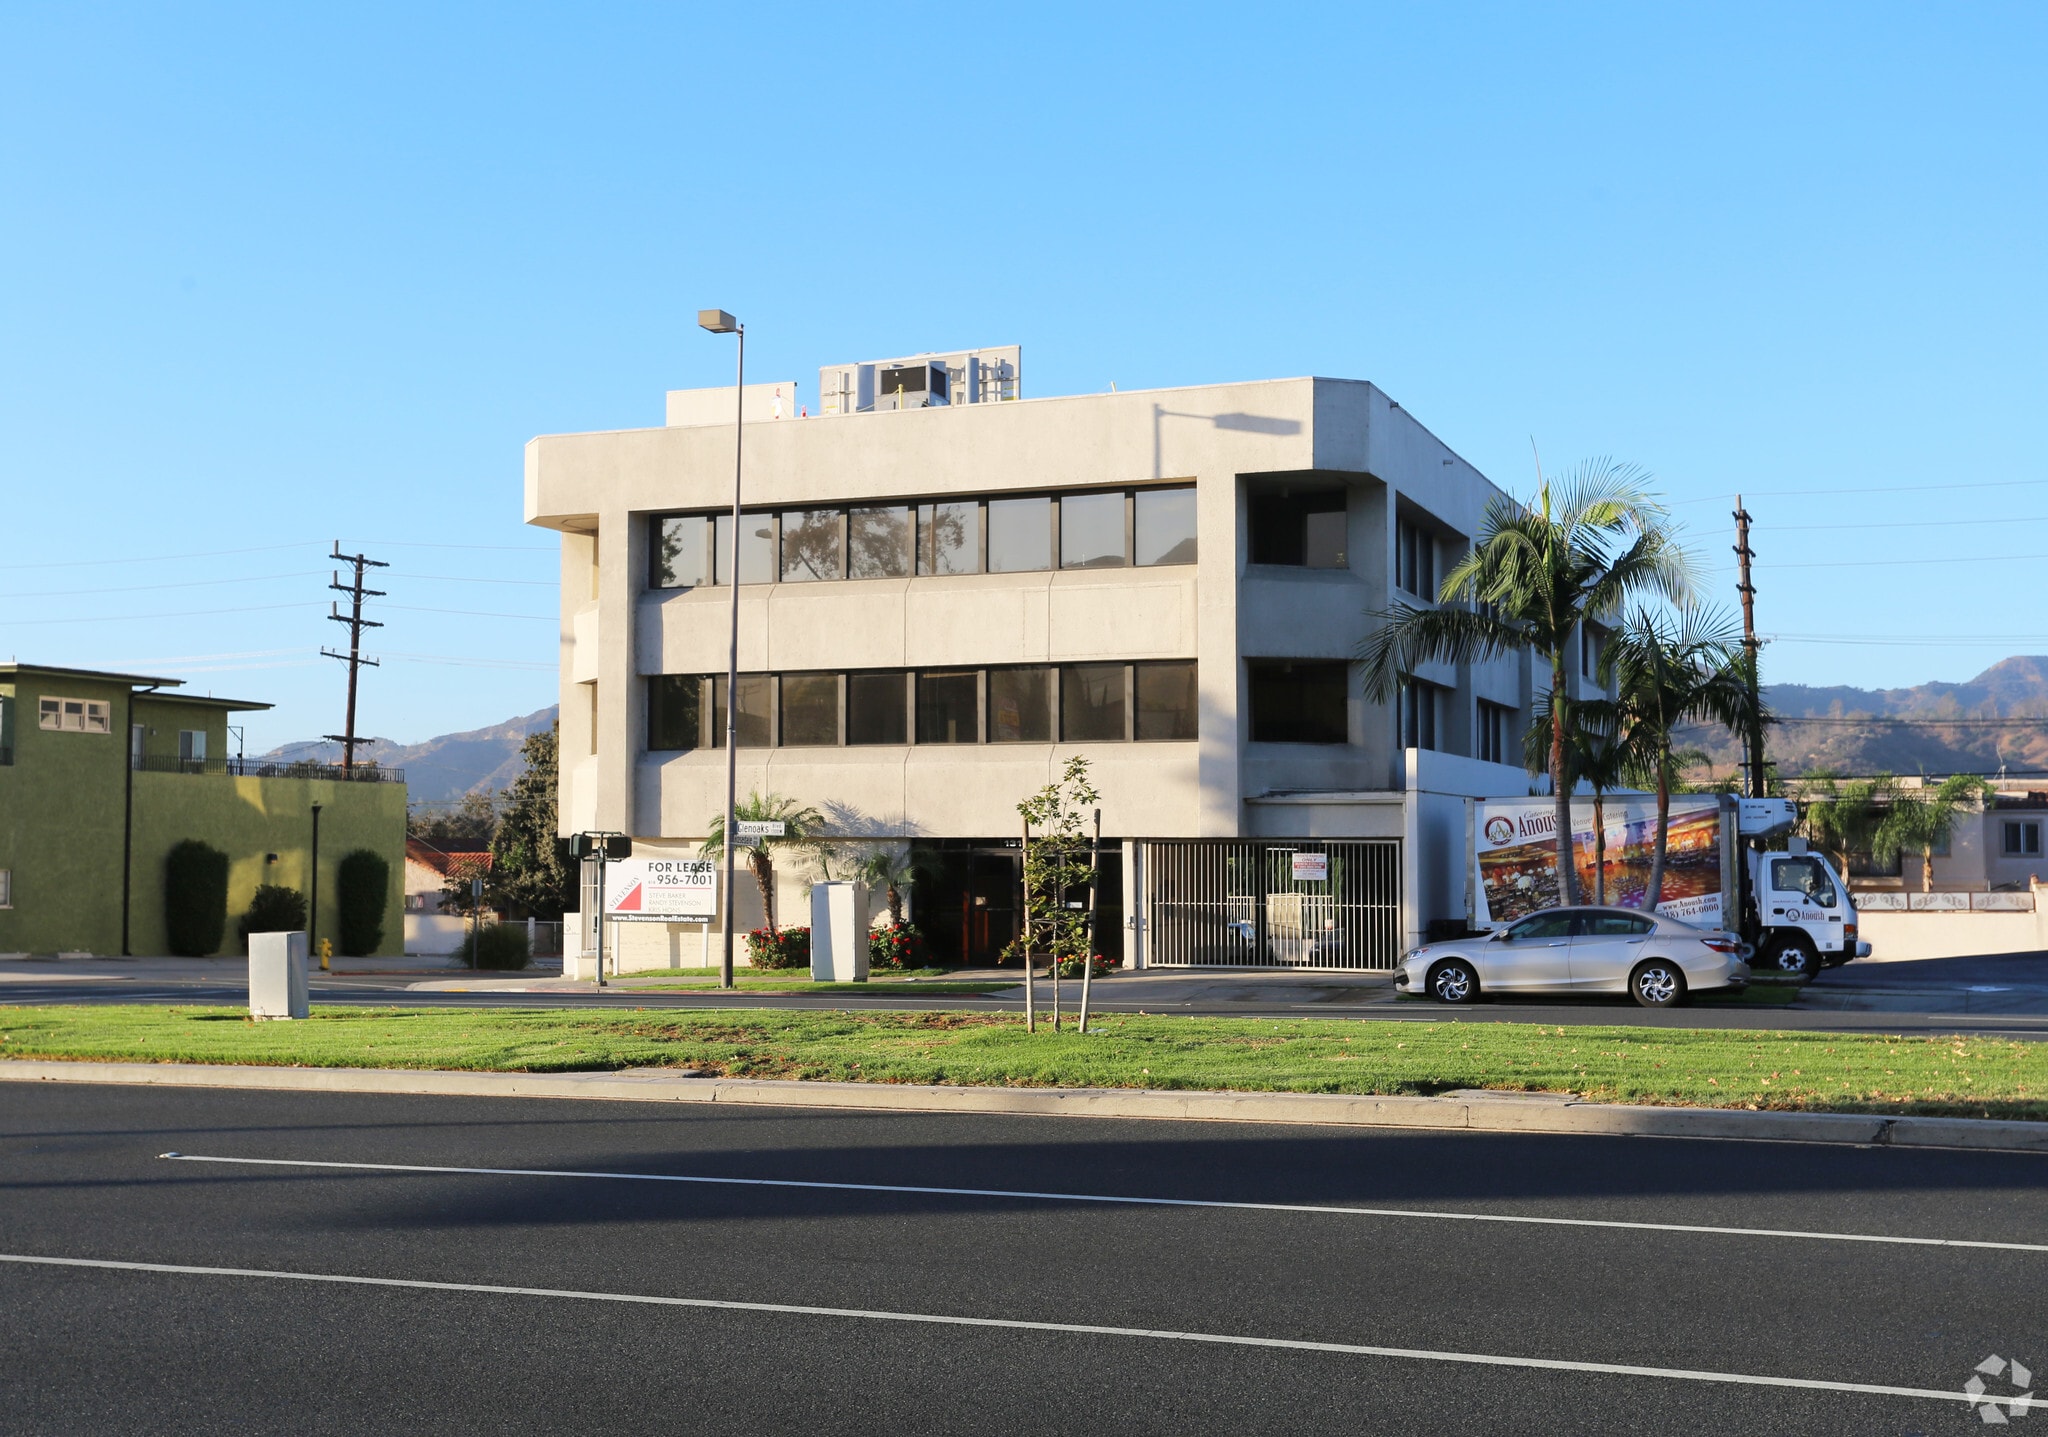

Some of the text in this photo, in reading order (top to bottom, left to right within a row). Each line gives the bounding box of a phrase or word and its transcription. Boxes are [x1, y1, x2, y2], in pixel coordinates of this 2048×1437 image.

[1523, 808, 1554, 819] Catering
[737, 823, 769, 834] Glenoaks
[1518, 814, 1557, 838] Anous
[648, 862, 713, 873] FOR LEASE
[657, 874, 712, 885] 956-7001
[609, 876, 640, 909] STEVENSON
[1662, 896, 1717, 911] www.Anoush.com
[1680, 903, 1719, 917] 764-0000
[611, 915, 709, 923] www.StevensonRealEstate.com
[1801, 911, 1825, 921] Anoush
